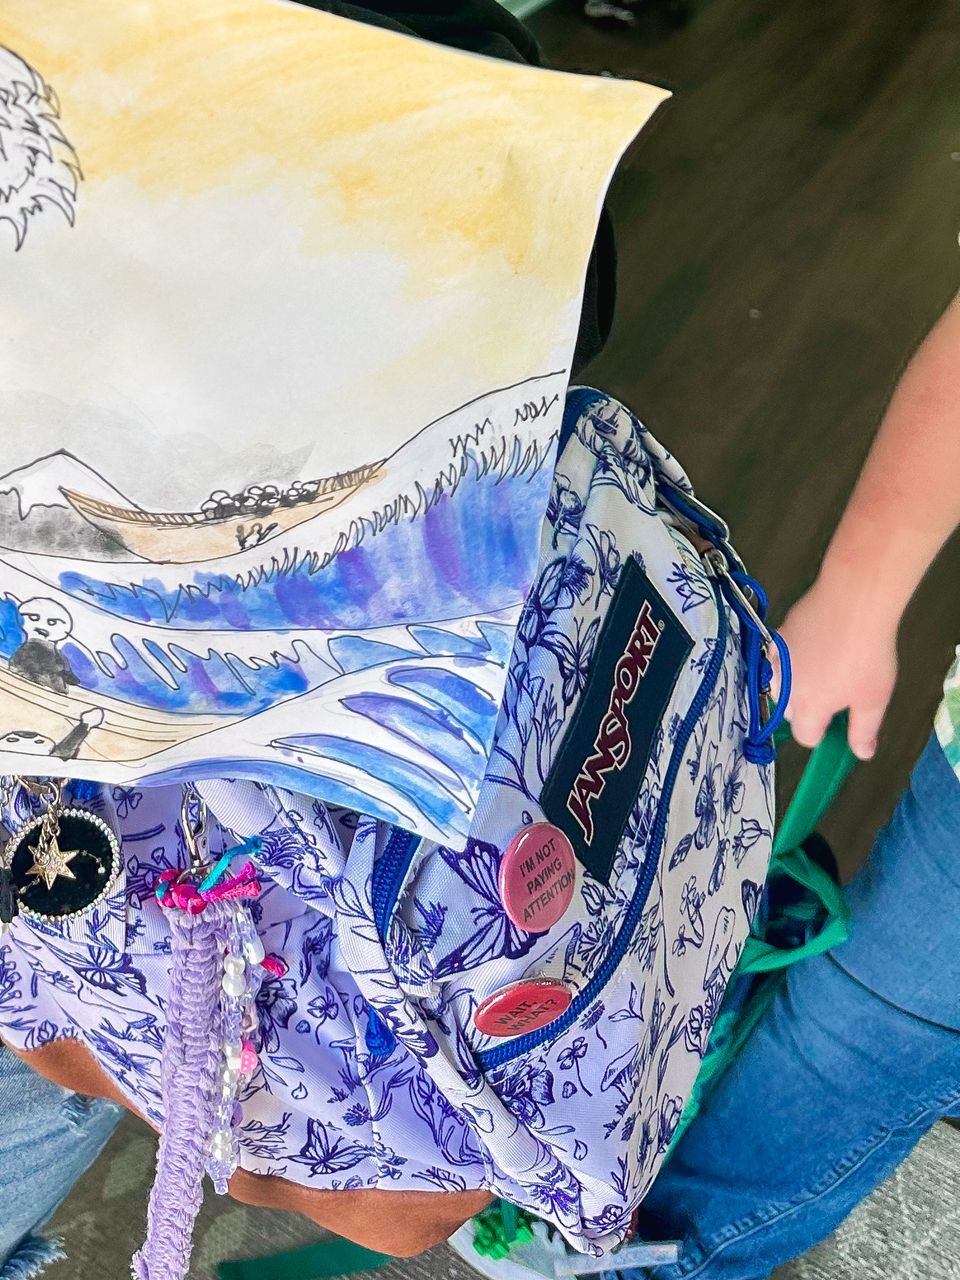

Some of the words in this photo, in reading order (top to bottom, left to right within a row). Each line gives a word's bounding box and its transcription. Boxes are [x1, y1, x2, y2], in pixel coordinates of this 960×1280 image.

[566, 599, 662, 846] JANSPORT
[519, 856, 536, 878] I'M
[536, 838, 557, 864] NOT
[526, 857, 562, 894] PAYING
[522, 868, 575, 922] ATTENTION
[507, 999, 557, 1030] WHAT?
